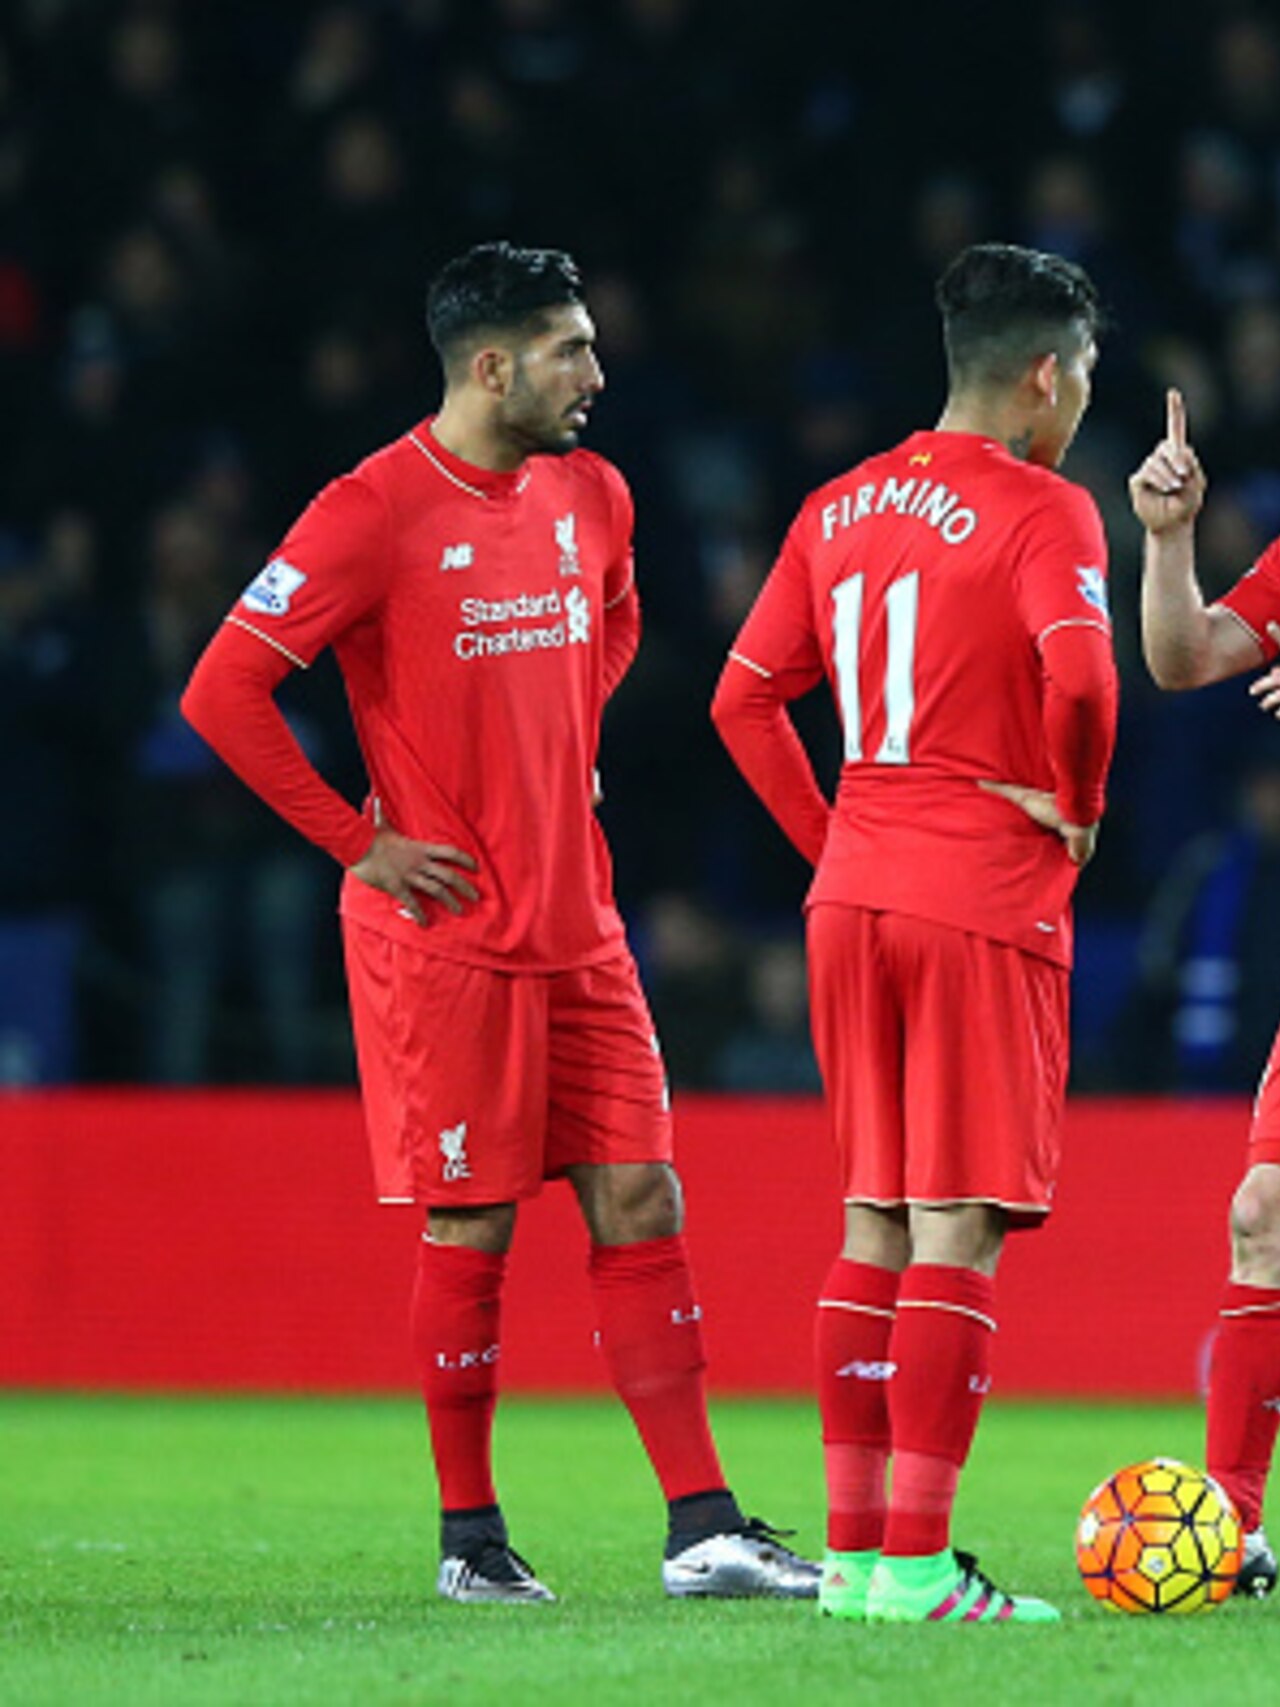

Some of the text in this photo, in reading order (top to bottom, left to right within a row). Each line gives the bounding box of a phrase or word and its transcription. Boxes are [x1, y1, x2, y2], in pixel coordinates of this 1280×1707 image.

[821, 477, 978, 544] FIRMINO
[460, 590, 561, 626] Standard
[453, 622, 566, 660] Chartered
[830, 569, 919, 765] 11
